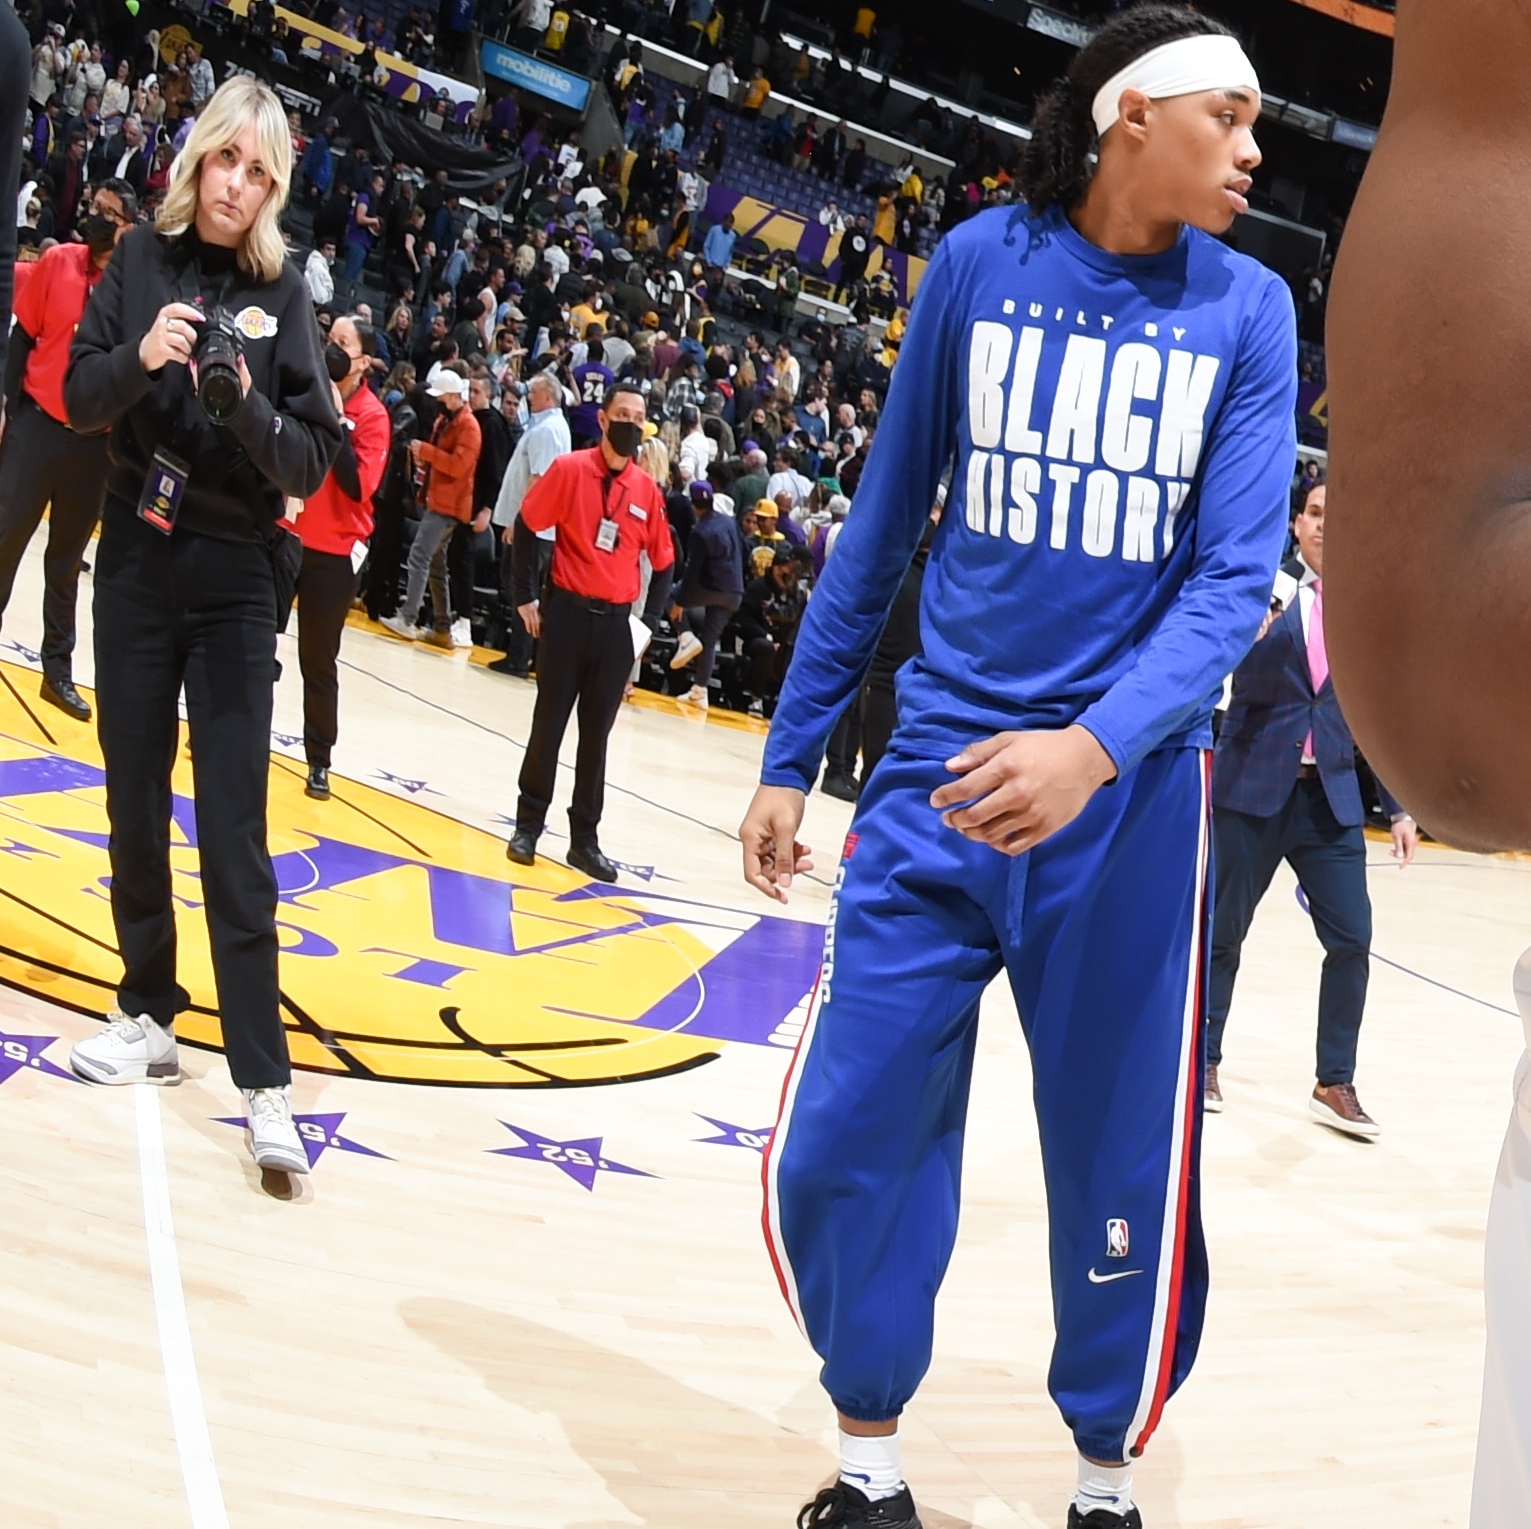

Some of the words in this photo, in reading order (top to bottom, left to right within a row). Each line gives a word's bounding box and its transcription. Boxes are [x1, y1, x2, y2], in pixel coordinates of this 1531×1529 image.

[495, 53, 572, 94] mobilitie
[273, 82, 323, 118] ESPN
[1002, 298, 1115, 330] BUILT
[1144, 321, 1187, 341] BY
[583, 380, 604, 404] 24
[968, 320, 1221, 478] BLACK
[965, 449, 1192, 563] HISTORY
[536, 1143, 610, 1169] '52
